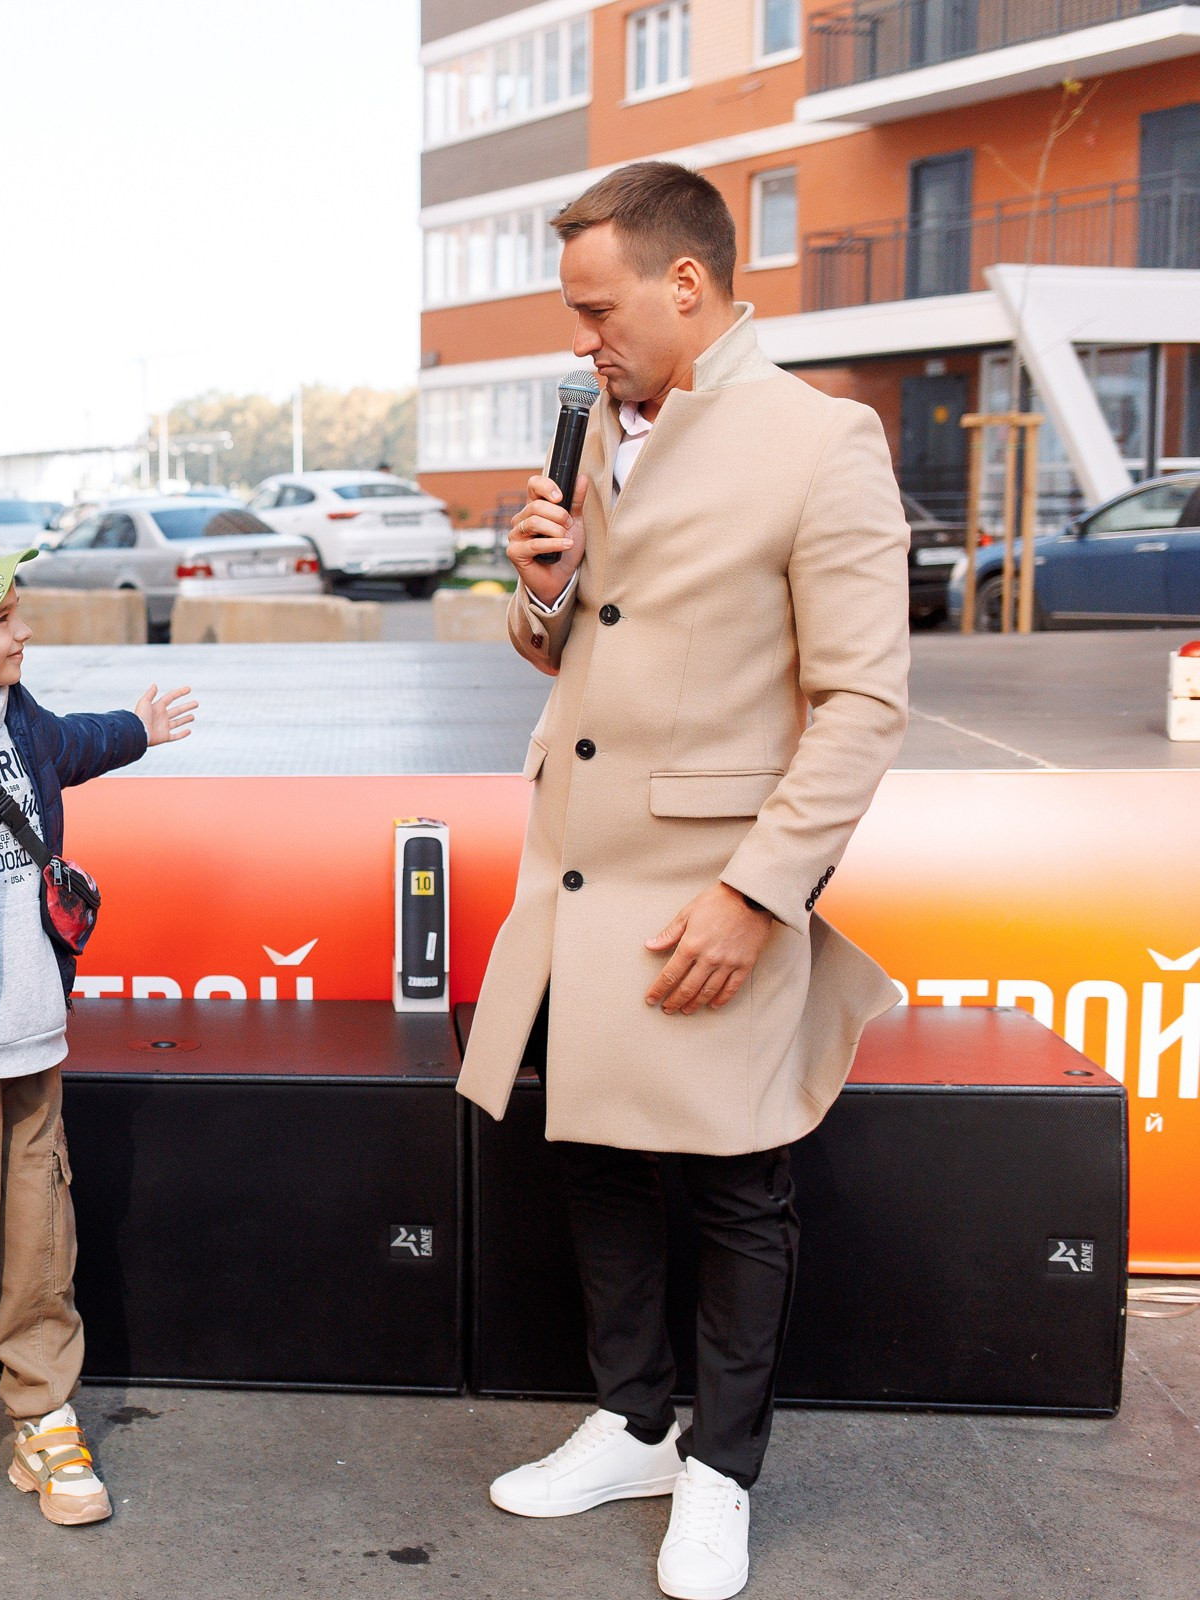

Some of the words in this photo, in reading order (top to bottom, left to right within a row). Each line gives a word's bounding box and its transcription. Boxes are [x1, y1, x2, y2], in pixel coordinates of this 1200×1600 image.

[415, 876, 431, 891] 1.0
[420, 1228, 433, 1257] FANE
[1080, 1242, 1094, 1272] FANE
